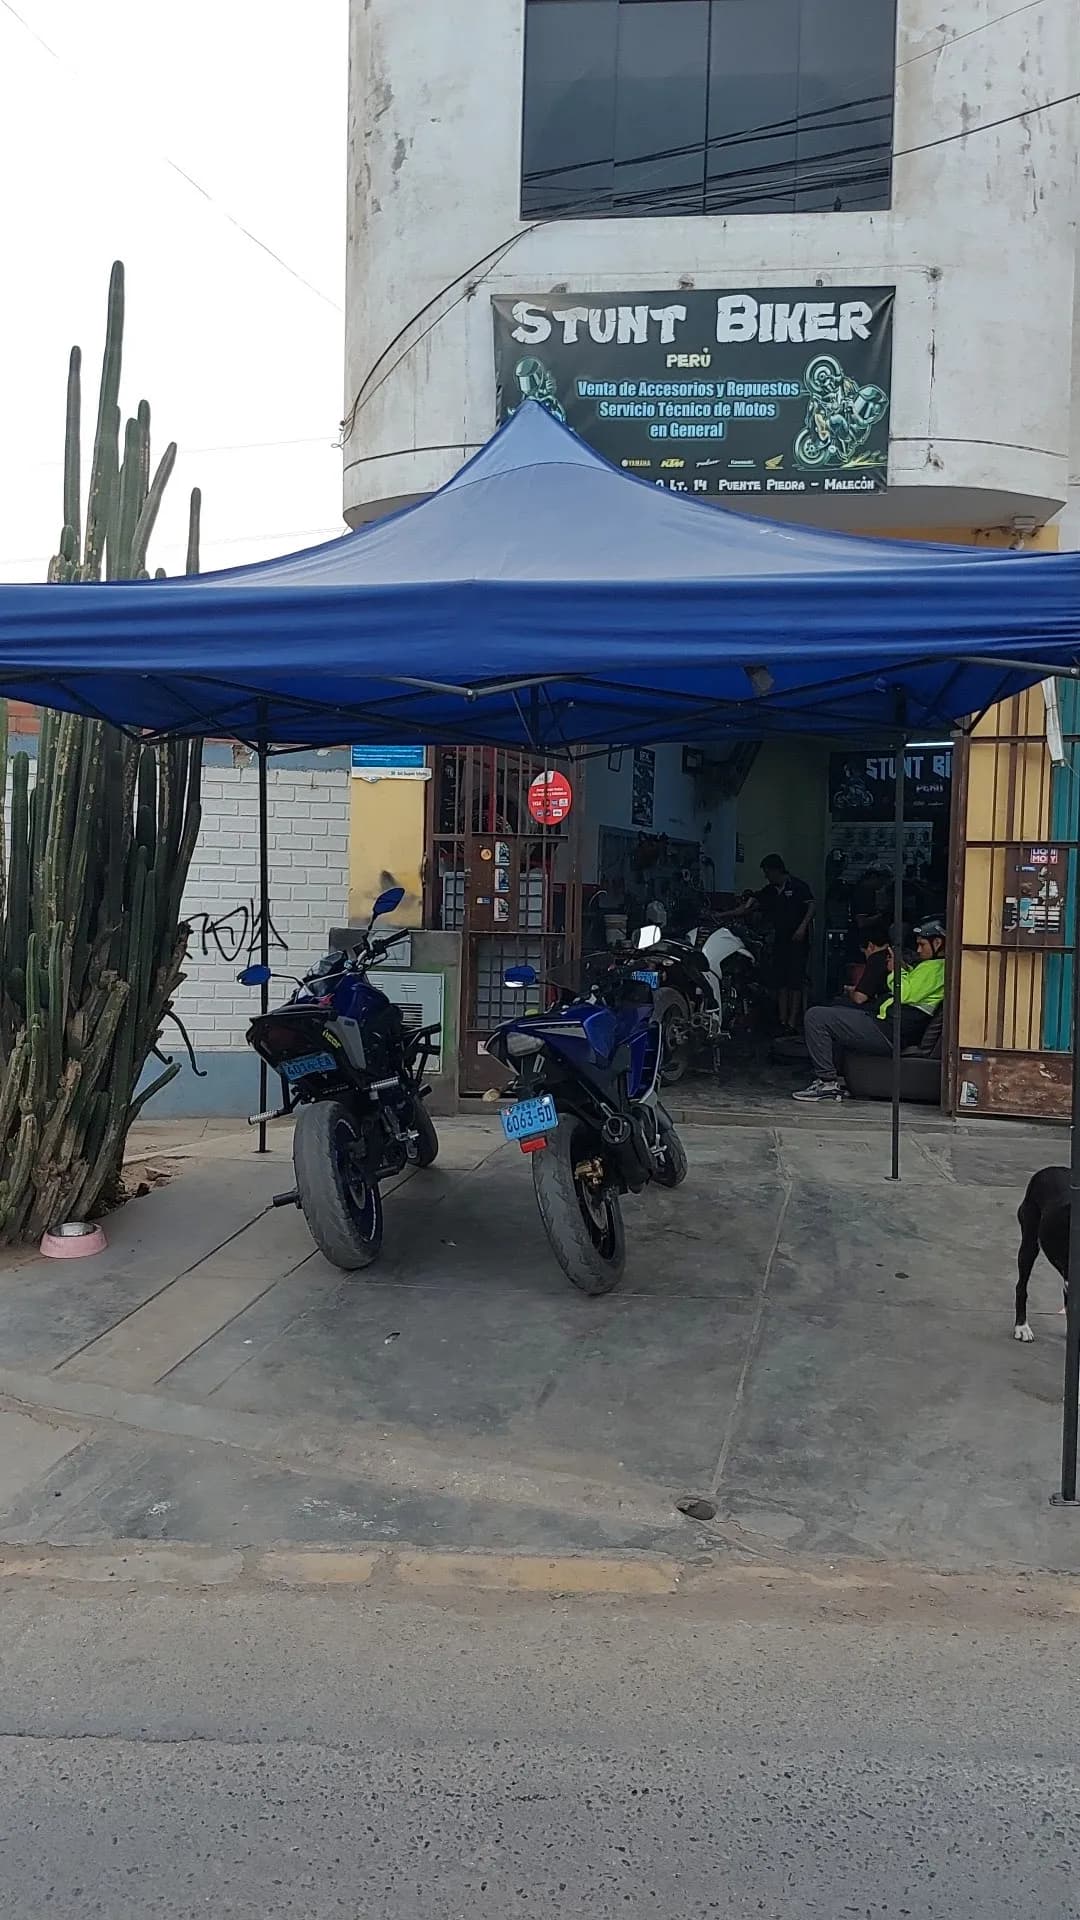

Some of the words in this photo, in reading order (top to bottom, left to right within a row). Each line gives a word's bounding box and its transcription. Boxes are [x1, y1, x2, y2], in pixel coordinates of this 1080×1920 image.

[512, 301, 687, 344] STUNT
[716, 294, 872, 343] BIKER
[666, 348, 712, 368] PERÚ
[578, 382, 617, 397] Venta
[620, 382, 636, 396] de
[639, 382, 713, 396] Accesorios
[717, 385, 725, 399] y
[727, 381, 799, 397] Repuestos
[600, 402, 655, 418] Servicio
[658, 401, 711, 417] Técnico
[714, 402, 731, 417] de
[734, 402, 775, 417] Motos
[650, 425, 666, 437] en
[670, 422, 723, 438] General
[660, 458, 685, 468] KTM
[693, 479, 707, 491] 14
[719, 479, 761, 490] PUENTE
[766, 479, 805, 490] PIEDRA
[825, 476, 874, 490] MALECÓN
[1032, 855, 1056, 863] MOY
[506, 1104, 553, 1134] 6063-5D
